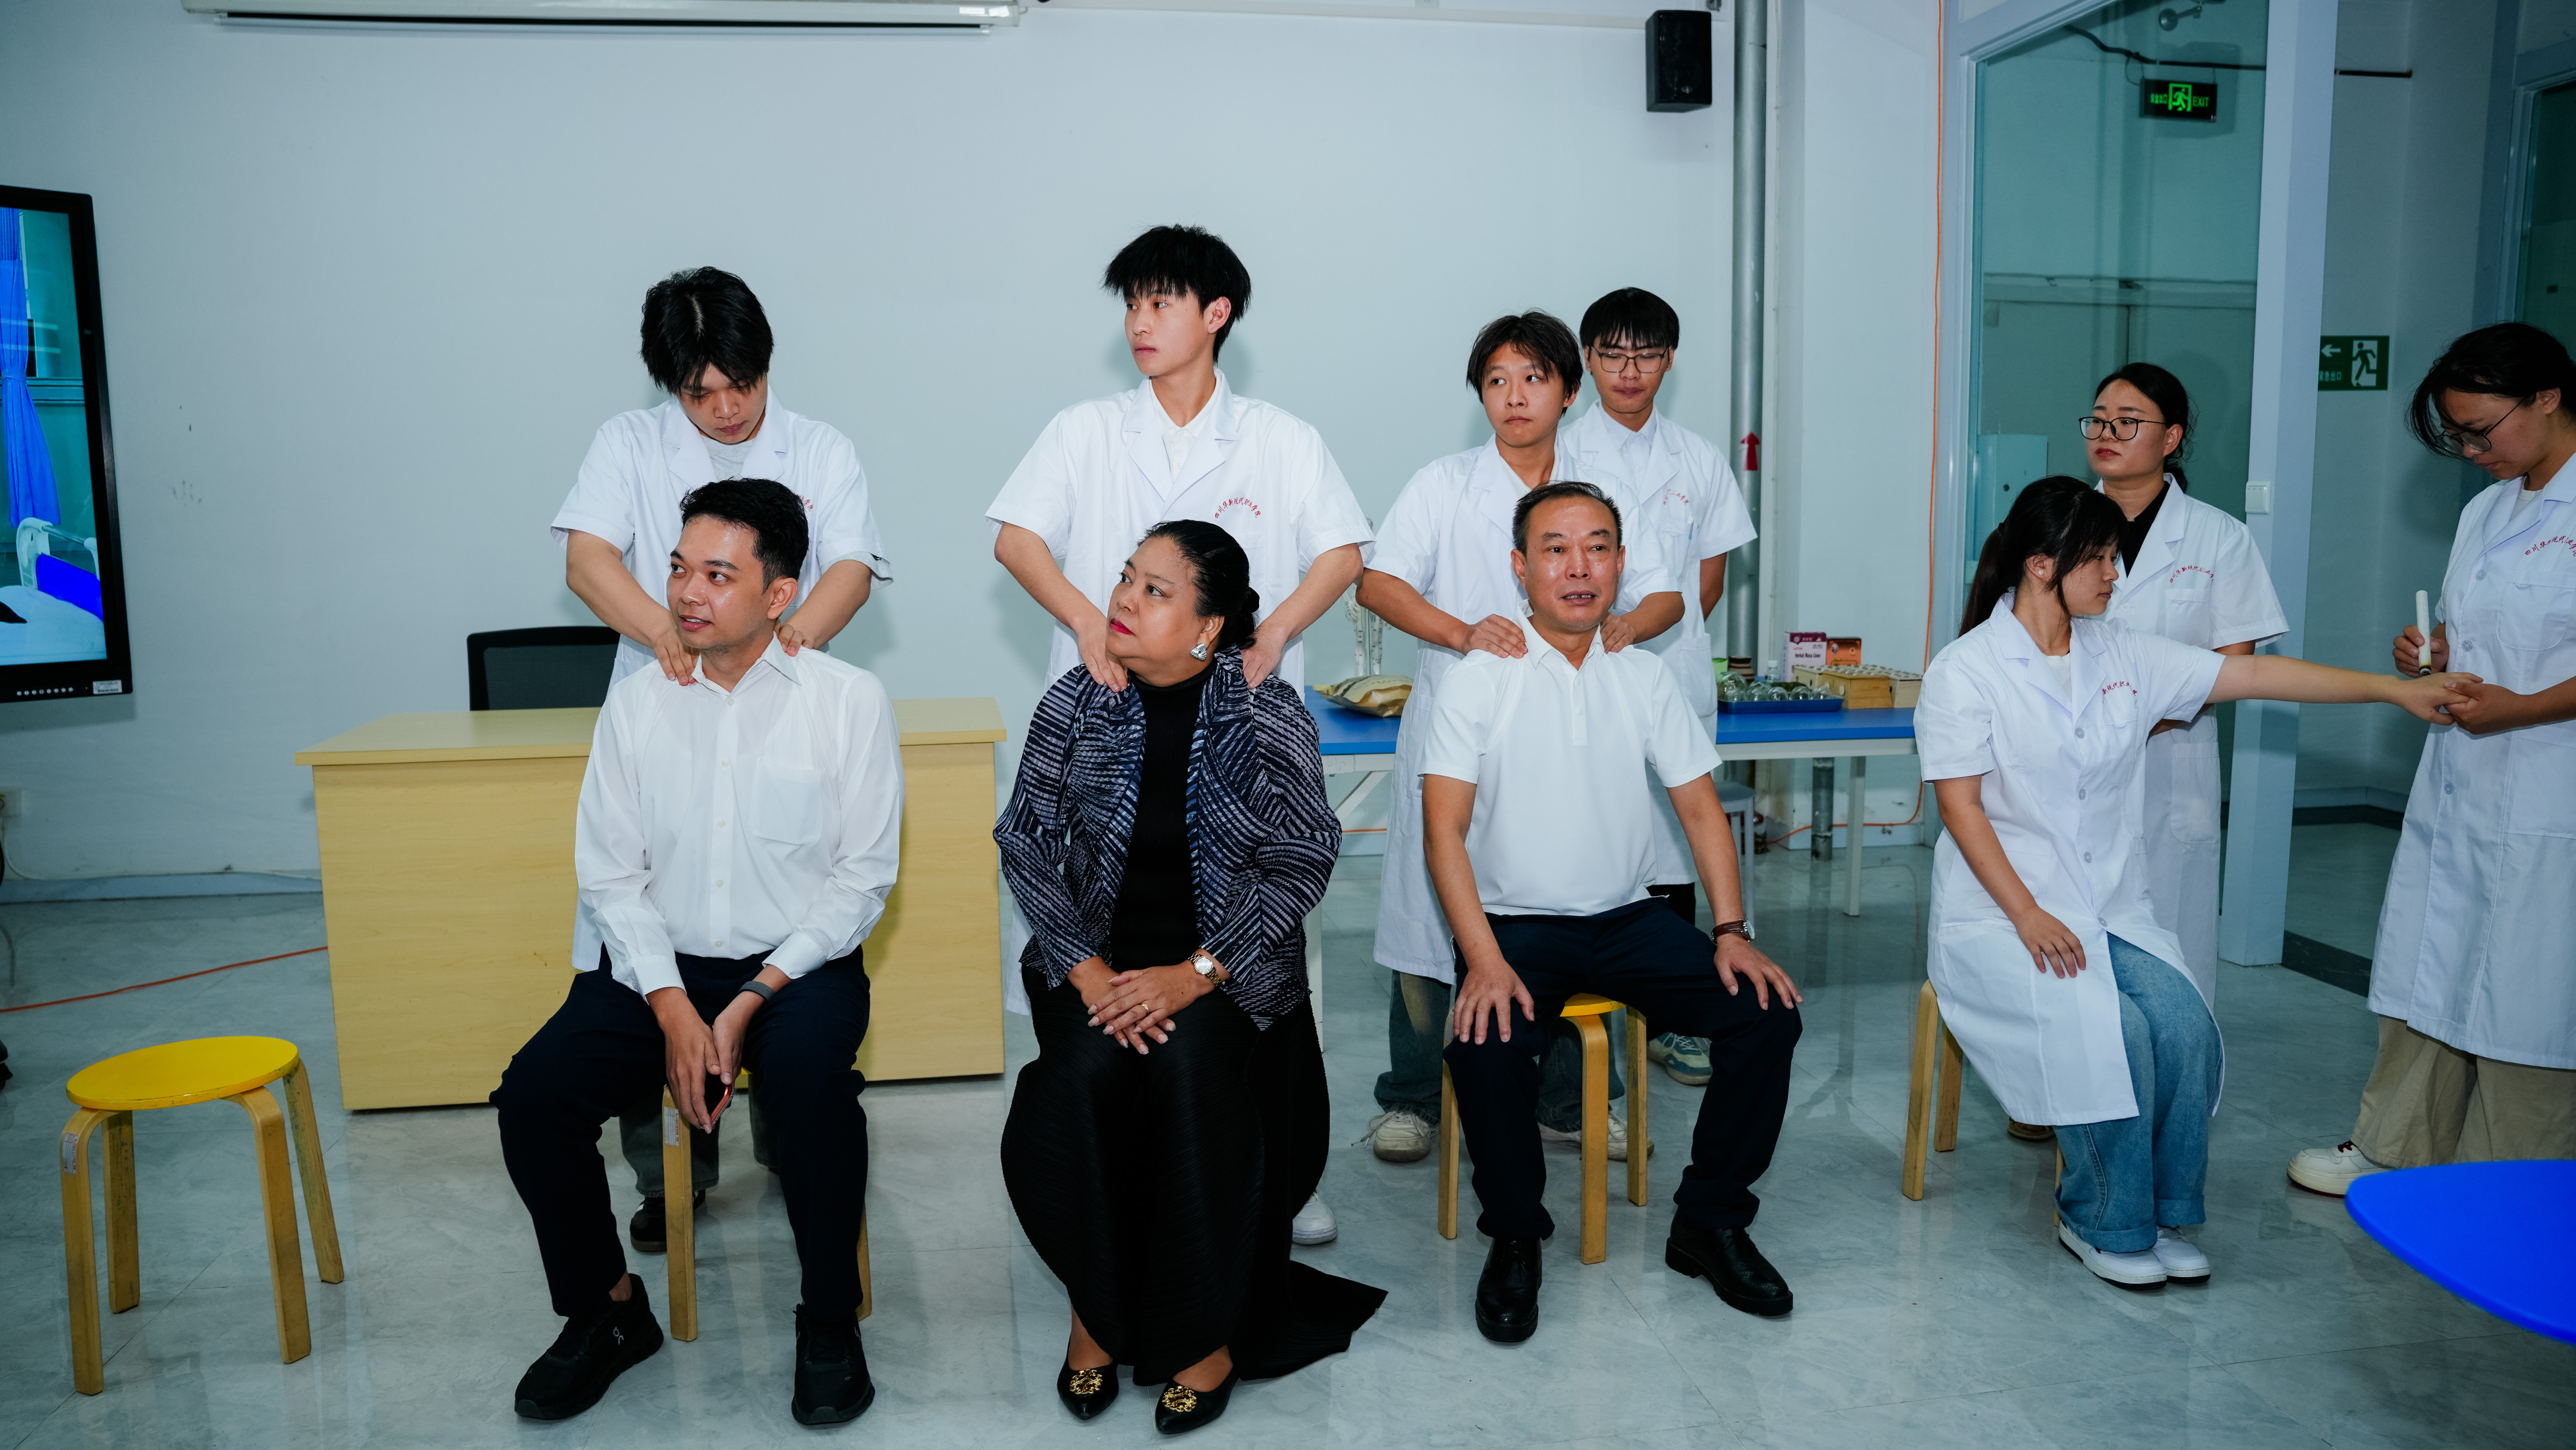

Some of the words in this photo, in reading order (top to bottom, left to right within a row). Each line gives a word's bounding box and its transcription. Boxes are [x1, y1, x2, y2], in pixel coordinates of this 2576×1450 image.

[2192, 96, 2209, 107] EXIT
[1215, 497, 1261, 518] 四川华新现代职业学院
